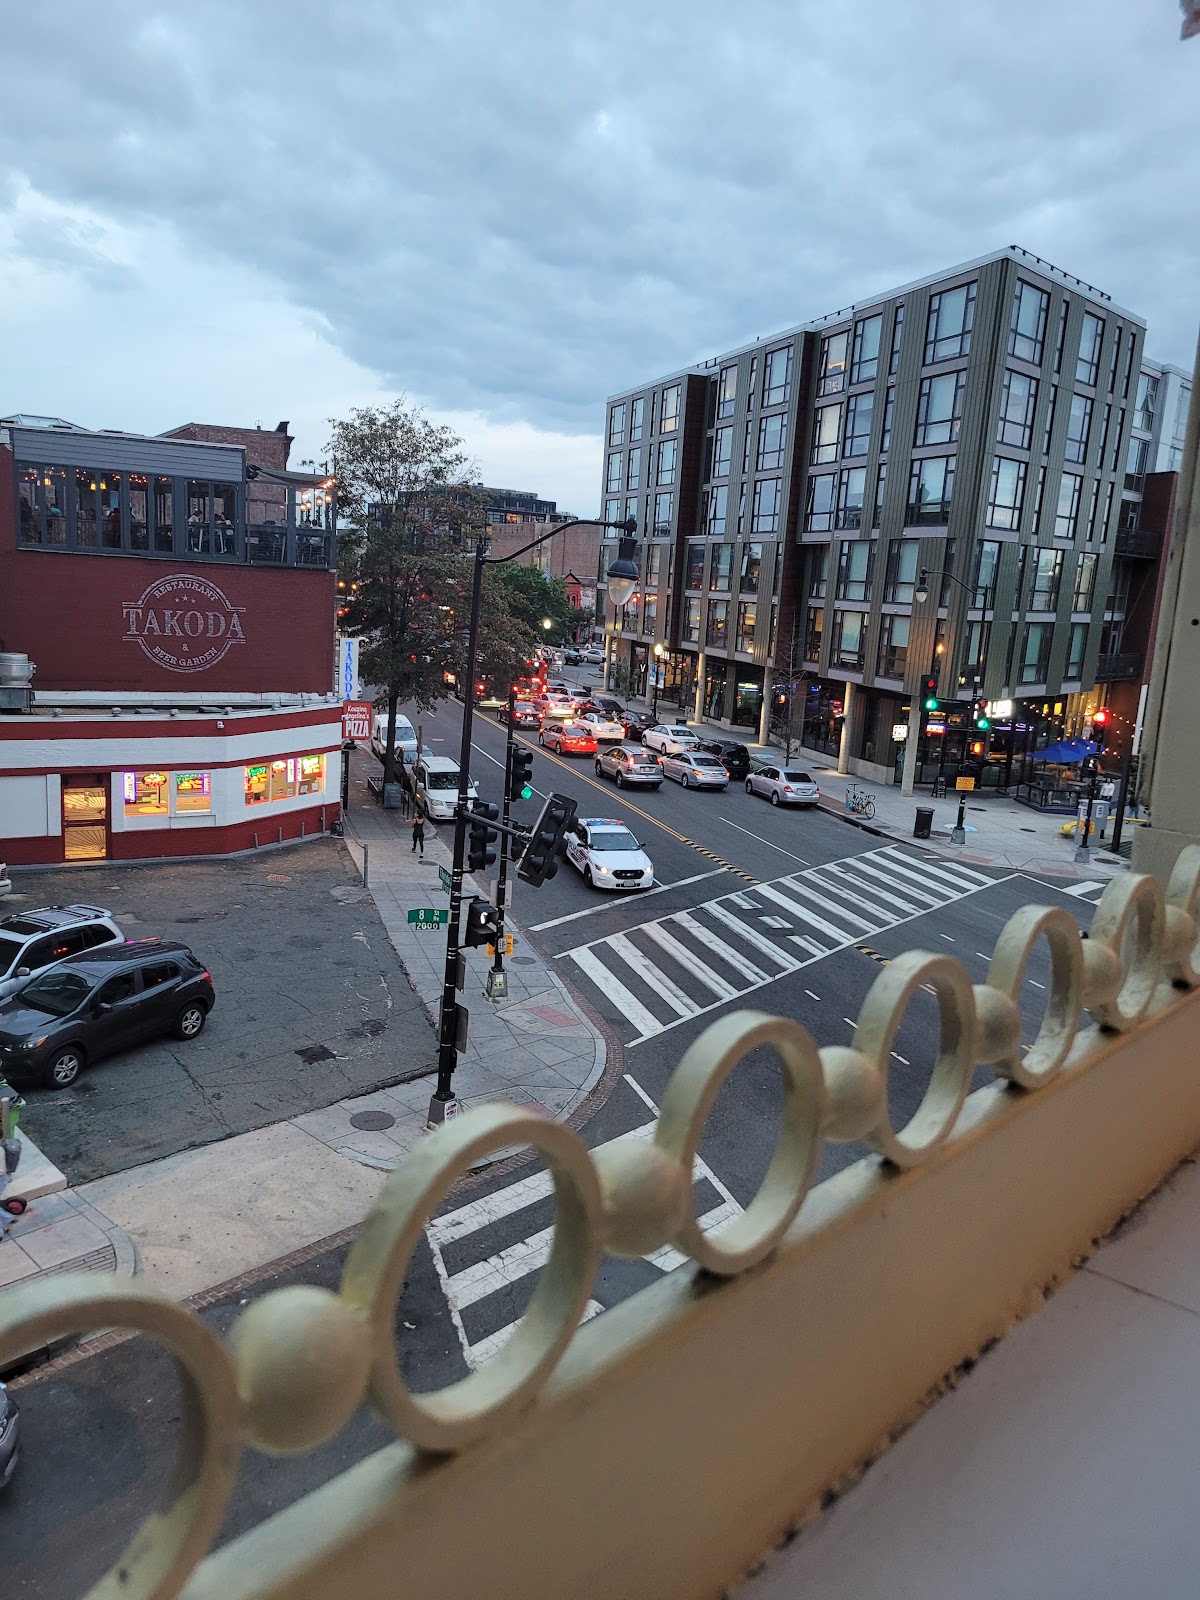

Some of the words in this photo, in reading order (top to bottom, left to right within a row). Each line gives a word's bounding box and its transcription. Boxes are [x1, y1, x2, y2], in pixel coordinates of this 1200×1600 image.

[154, 581, 218, 601] RESTAURANT
[122, 609, 245, 638] TAKODA
[152, 646, 177, 664] BEER
[179, 647, 218, 666] GARDEN
[182, 643, 190, 652] &
[344, 641, 353, 700] TAKODA
[345, 721, 369, 736] PIZZA
[418, 909, 425, 920] 8
[416, 922, 439, 930] 2000
